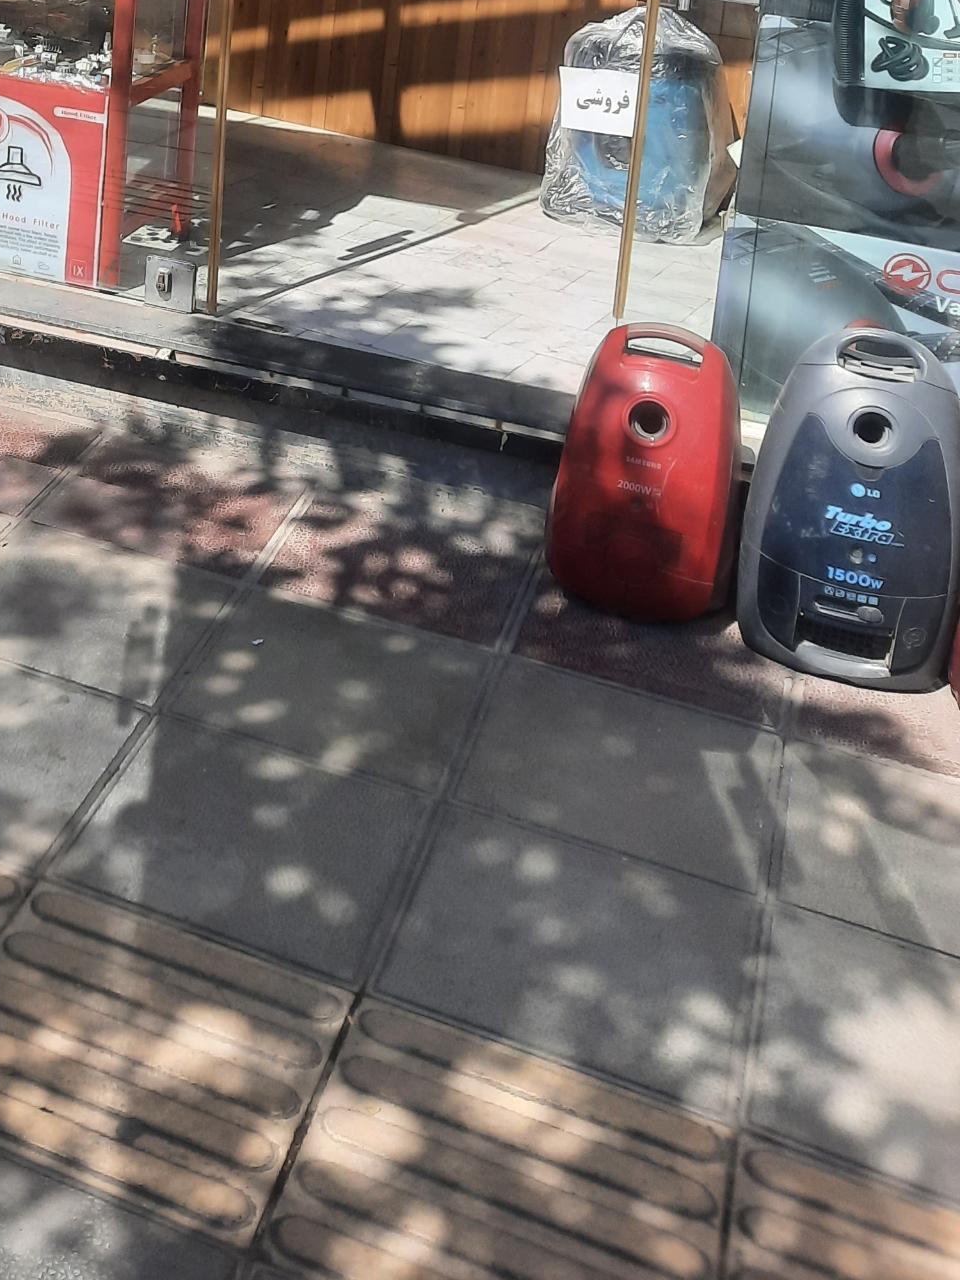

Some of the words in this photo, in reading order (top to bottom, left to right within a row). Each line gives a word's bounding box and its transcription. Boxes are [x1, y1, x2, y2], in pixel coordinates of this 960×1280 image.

[576, 90, 630, 115] فروشی
[2, 211, 27, 224] Hood
[33, 218, 61, 230] Filter
[616, 479, 652, 495] 2000W
[866, 488, 881, 498] LG
[825, 505, 892, 531] Turbo
[830, 521, 895, 545] Extra
